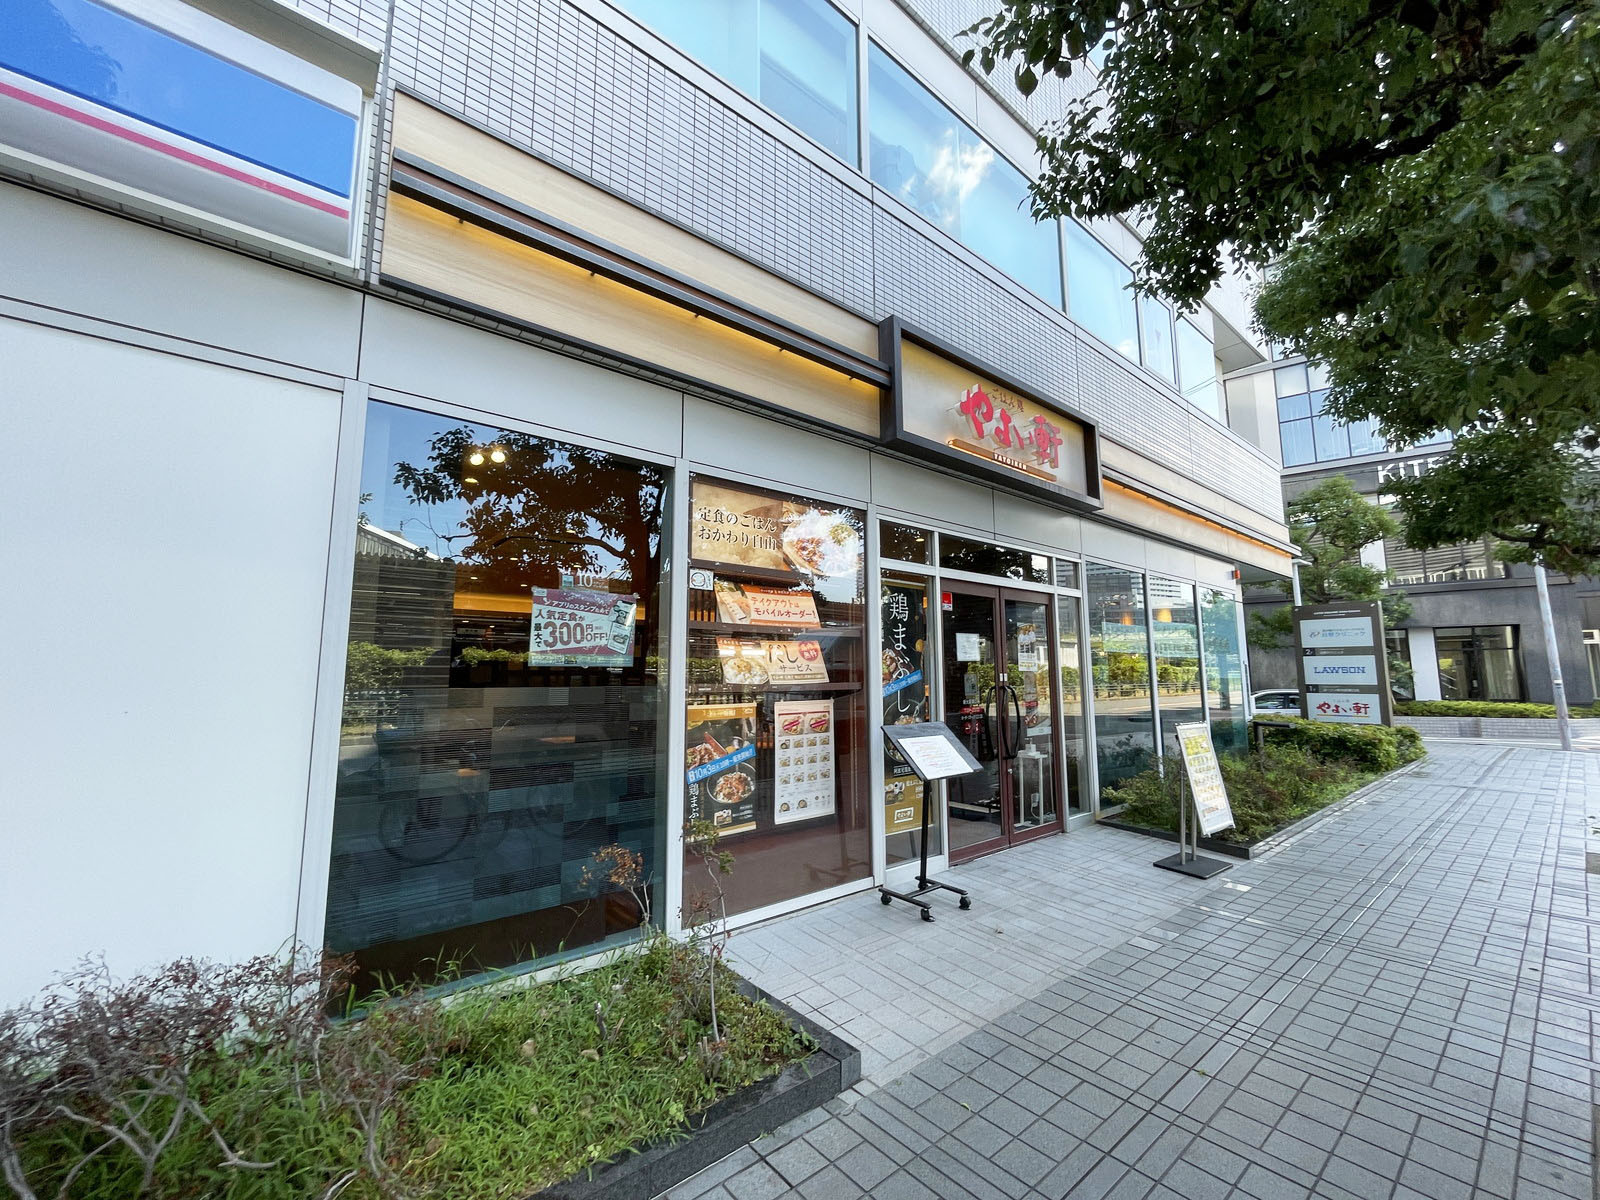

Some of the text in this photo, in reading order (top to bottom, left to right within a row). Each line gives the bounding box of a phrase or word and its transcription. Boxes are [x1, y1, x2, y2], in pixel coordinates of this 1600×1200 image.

[957, 384, 1063, 468] やよい軒
[698, 506, 776, 532] 定食のごはん
[698, 525, 777, 551] おかわり自由
[534, 608, 586, 622] 人気定食が
[543, 621, 585, 649] 300
[585, 632, 608, 642] OFF!
[889, 592, 911, 713] 鶏まぶし
[1313, 666, 1366, 674] LAWSON
[1316, 701, 1370, 715] やよい軒
